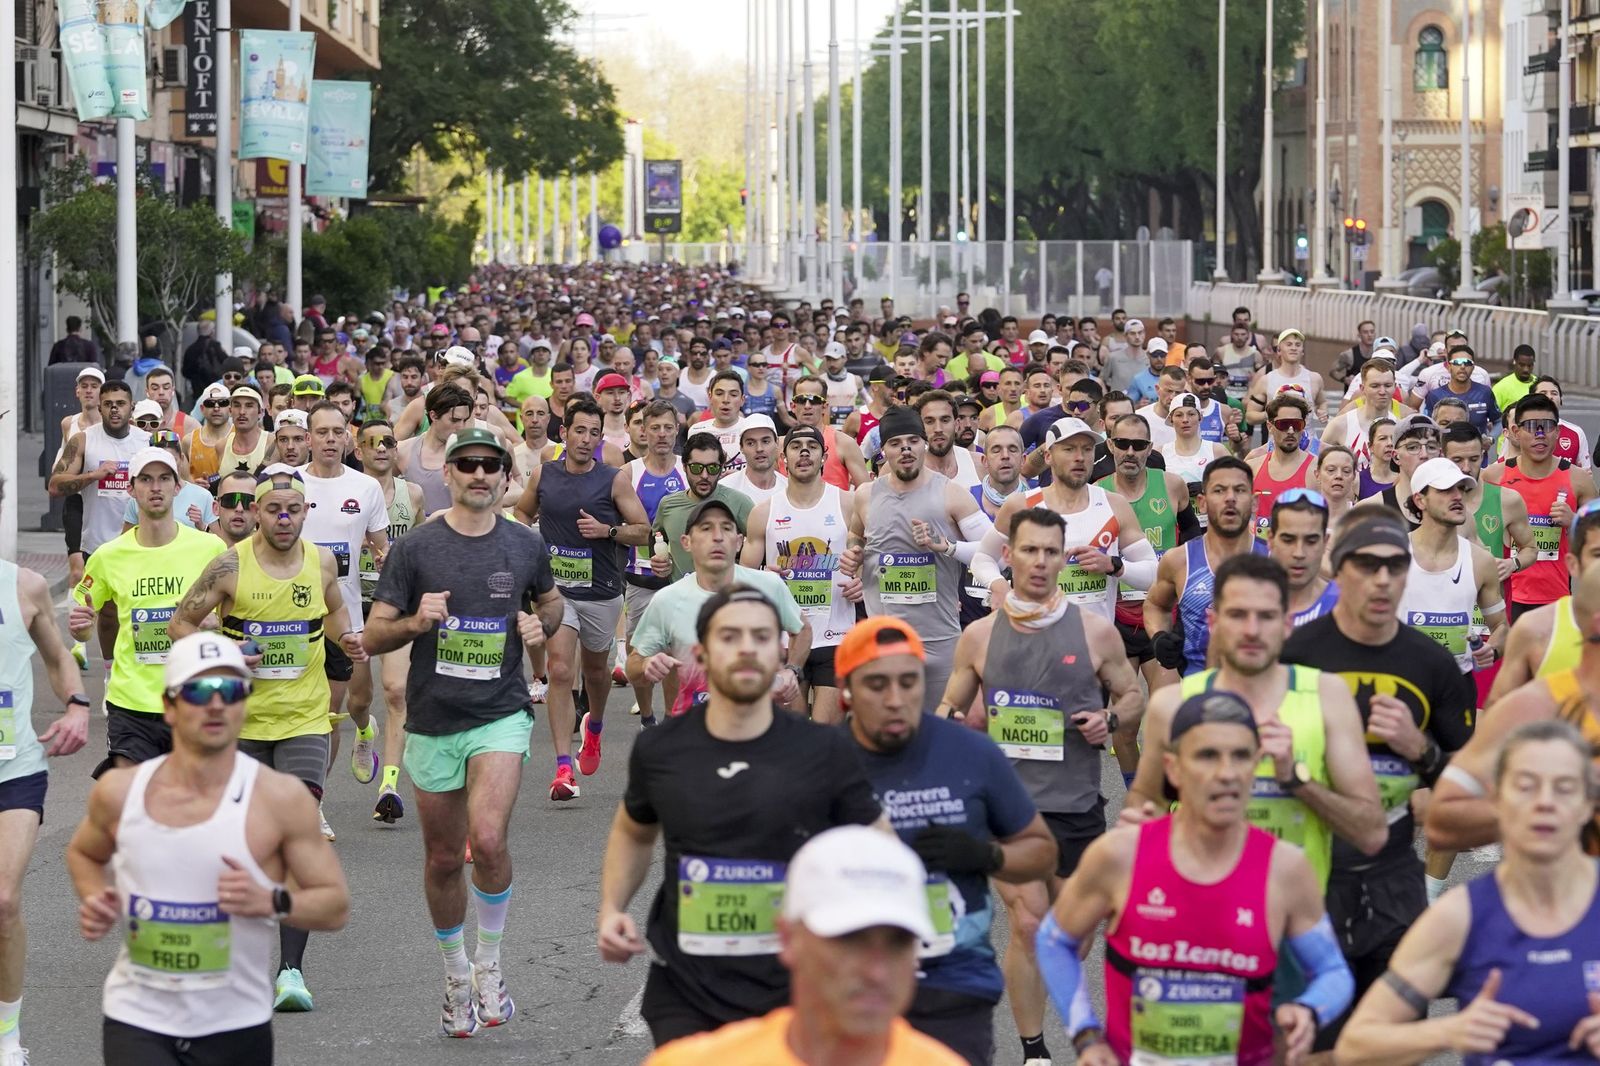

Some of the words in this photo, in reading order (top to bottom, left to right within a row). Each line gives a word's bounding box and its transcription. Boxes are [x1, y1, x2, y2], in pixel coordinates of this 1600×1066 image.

[560, 549, 587, 557] ZURICH
[897, 556, 929, 564] ZURICH
[797, 571, 826, 579] ZURICH
[899, 571, 916, 579] 2857
[132, 576, 184, 597] JEREMY
[884, 581, 902, 592] MR
[904, 580, 931, 592] PAID.
[463, 620, 500, 630] ZURICH
[1429, 616, 1463, 624] ZURICH
[266, 623, 302, 633] ZURICH
[463, 639, 484, 648] 2754
[438, 648, 464, 663] TOM
[1013, 694, 1054, 706] ZURICH
[1002, 728, 1049, 743] NACHO
[884, 786, 951, 805] Carrera
[889, 798, 965, 819] Nocturna
[713, 865, 774, 880] ZURICH
[158, 904, 218, 920] ZURICH
[706, 909, 757, 933] LEÓN
[1129, 935, 1173, 962] Los
[152, 949, 201, 970] FRED
[1167, 983, 1234, 1000] ZURICH
[1138, 1030, 1231, 1055] HERRERA
